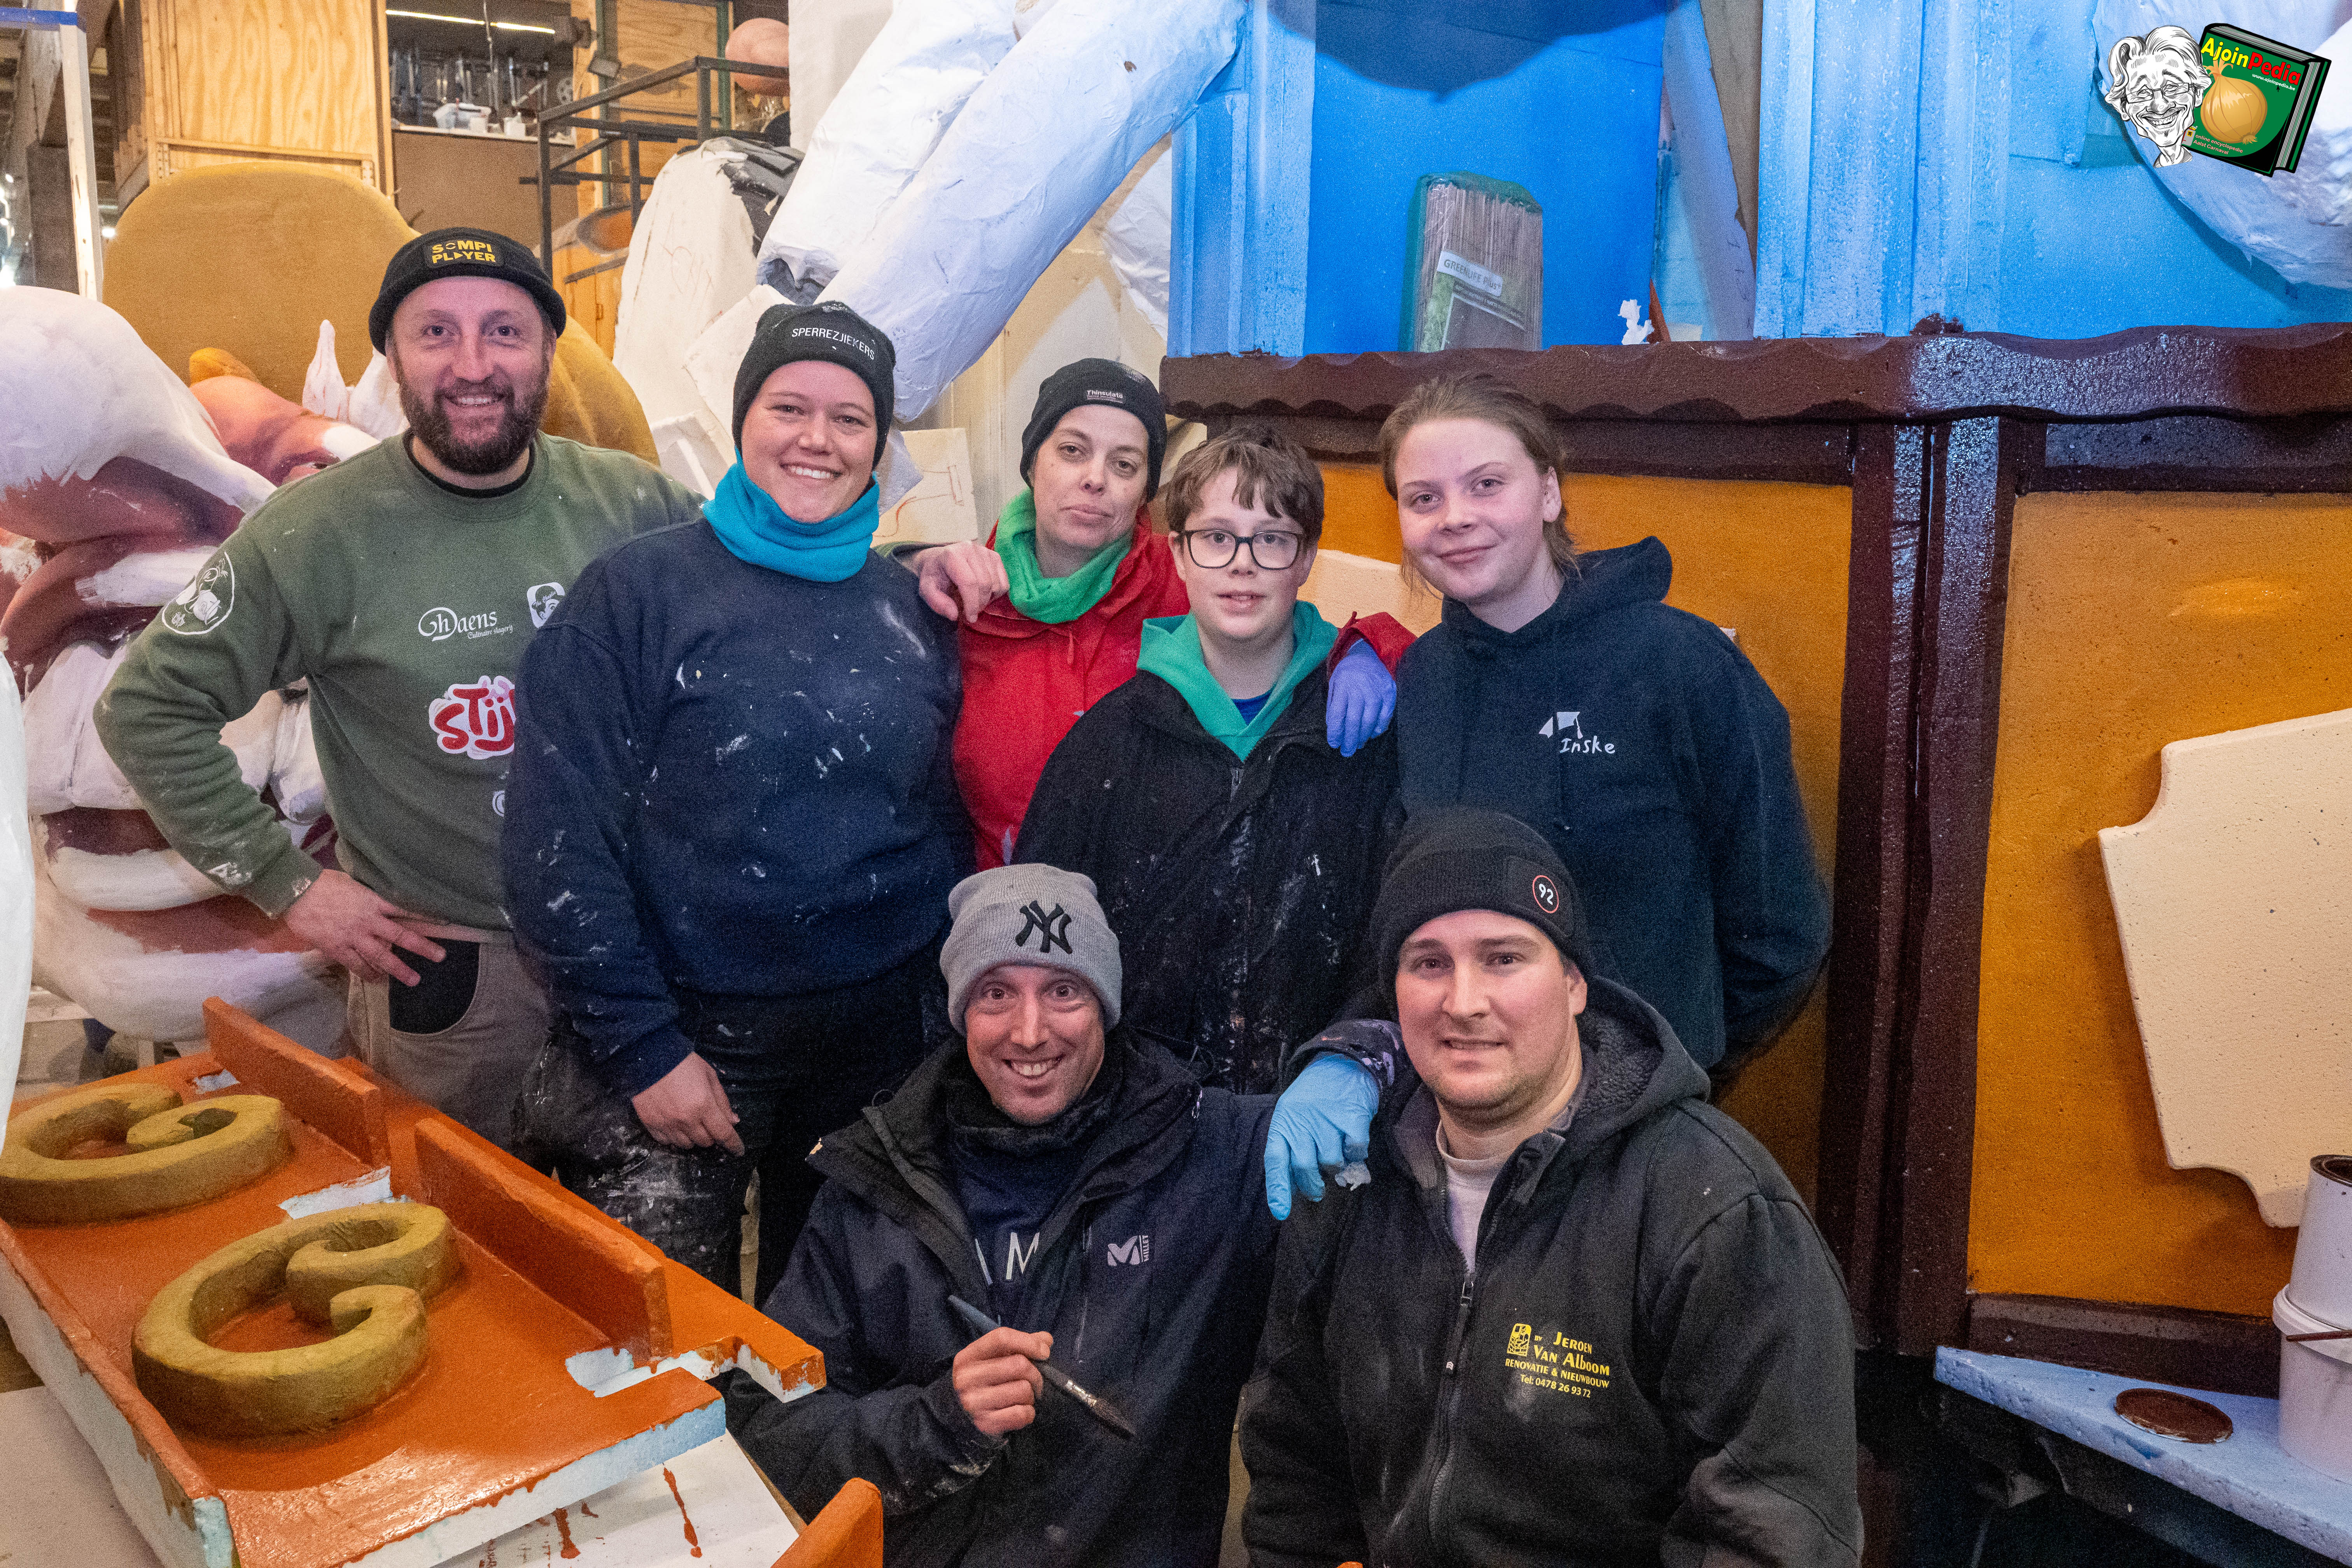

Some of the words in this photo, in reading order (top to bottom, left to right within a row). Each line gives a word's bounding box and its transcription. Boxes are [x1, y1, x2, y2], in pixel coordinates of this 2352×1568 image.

[432, 240, 492, 253] SOMPI
[432, 251, 496, 263] PLAYER
[1087, 390, 1123, 399] Thinsulate
[1559, 735, 1615, 754] Inske
[1539, 884, 1554, 905] 92
[1015, 900, 1073, 954] NY
[1505, 1358, 1549, 1374] RENOVATIE
[1551, 1368, 1558, 1377] &
[1561, 1370, 1610, 1388] NIEUWBOUW
[1520, 1374, 1533, 1384] Tel:
[1535, 1378, 1556, 1389] 0478
[1558, 1383, 1570, 1393] 26
[1571, 1386, 1582, 1395] 93
[1583, 1388, 1591, 1398] 72
